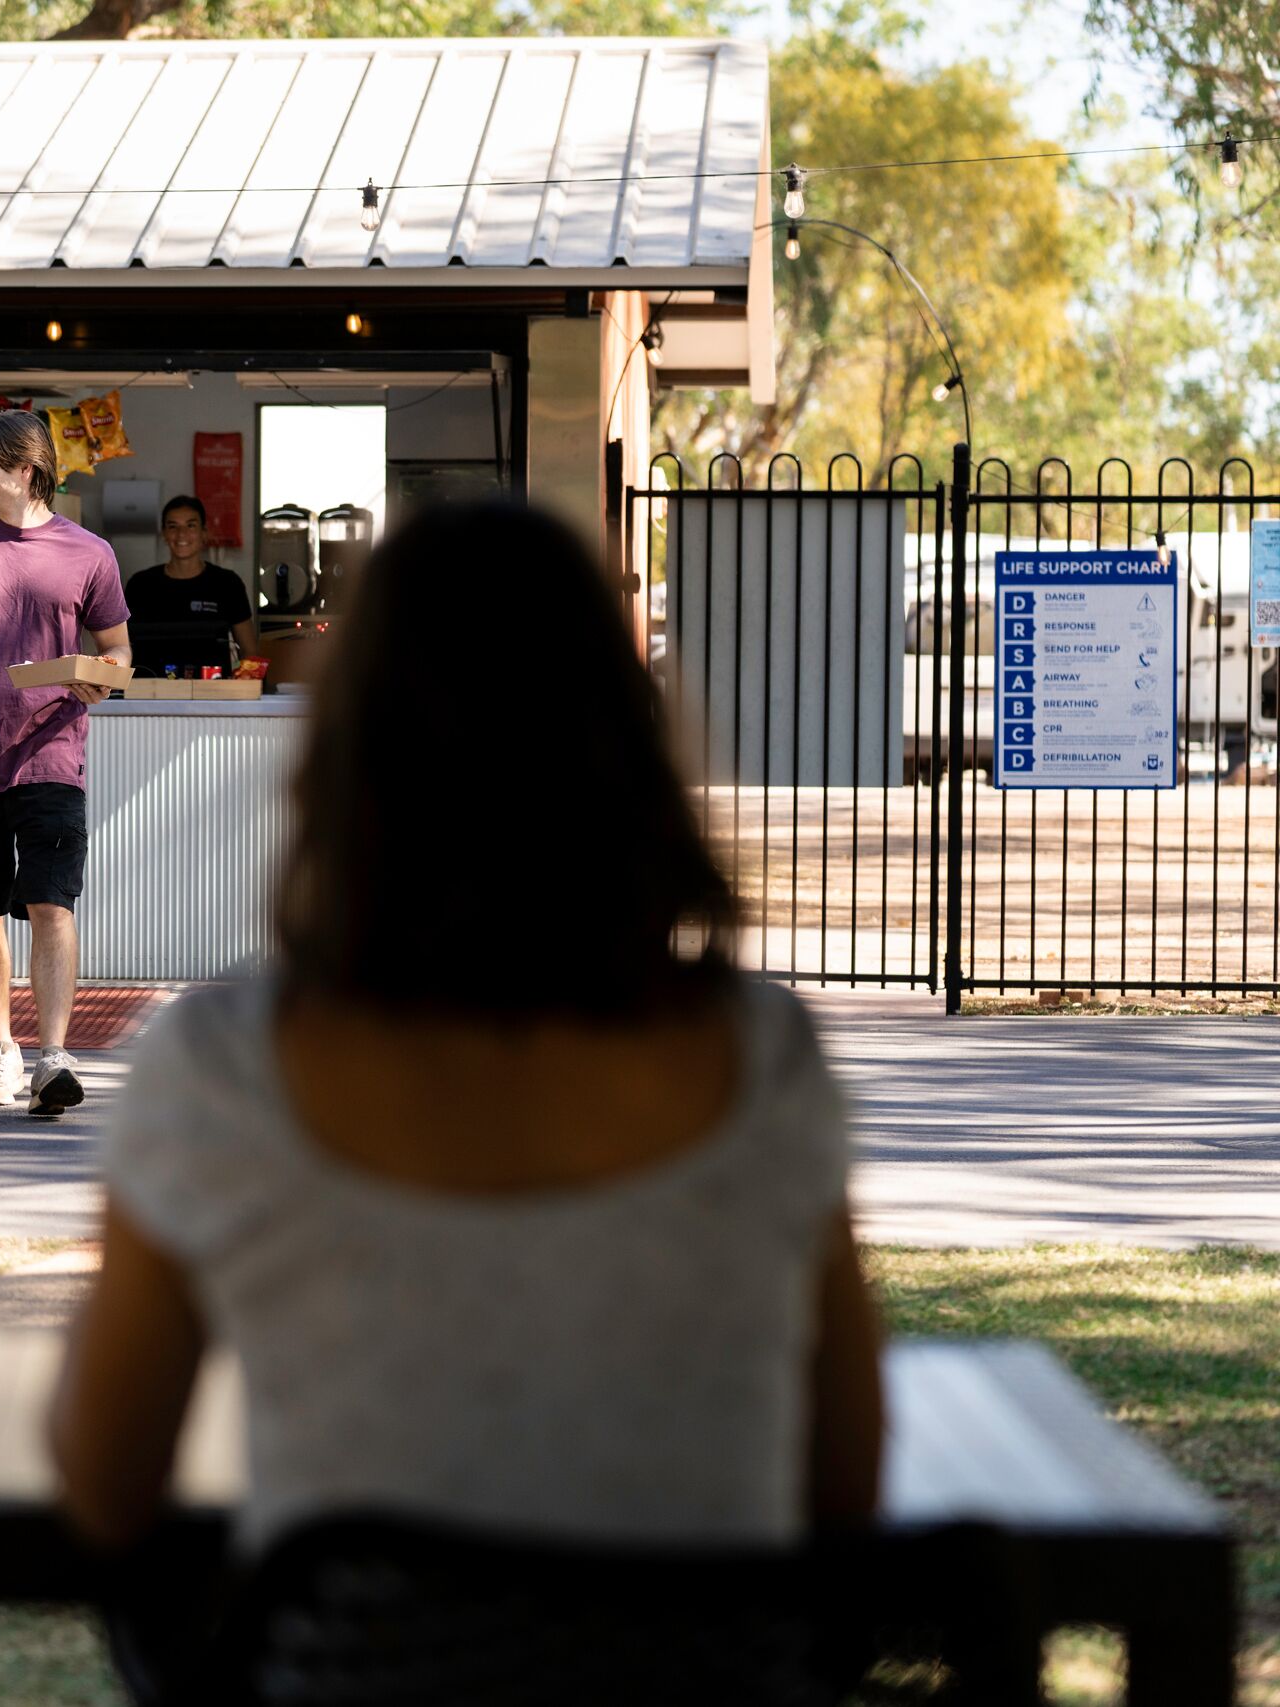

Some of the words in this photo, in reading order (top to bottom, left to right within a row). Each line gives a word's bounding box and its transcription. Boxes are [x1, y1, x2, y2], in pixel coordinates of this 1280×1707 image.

[1002, 561, 1035, 575] LIFE
[1039, 561, 1112, 575] SUPPORT
[1116, 561, 1171, 575] CHART
[1013, 596, 1026, 611] D
[1044, 592, 1086, 601] DANGER
[1013, 623, 1025, 637] R
[1044, 622, 1096, 631] RESPONSE
[1044, 644, 1071, 653] SEND
[1073, 645, 1093, 653] FOR
[1096, 645, 1121, 653] HELP
[1013, 649, 1025, 663] S
[1012, 675, 1026, 690] A
[1043, 673, 1081, 681] AIRWAY
[1013, 701, 1025, 716] B
[1043, 699, 1099, 708] BREATHING
[1012, 727, 1025, 742] C
[1043, 724, 1063, 733] CPR
[1012, 753, 1025, 768] D
[1043, 753, 1122, 761] DEFRIBILLATION
